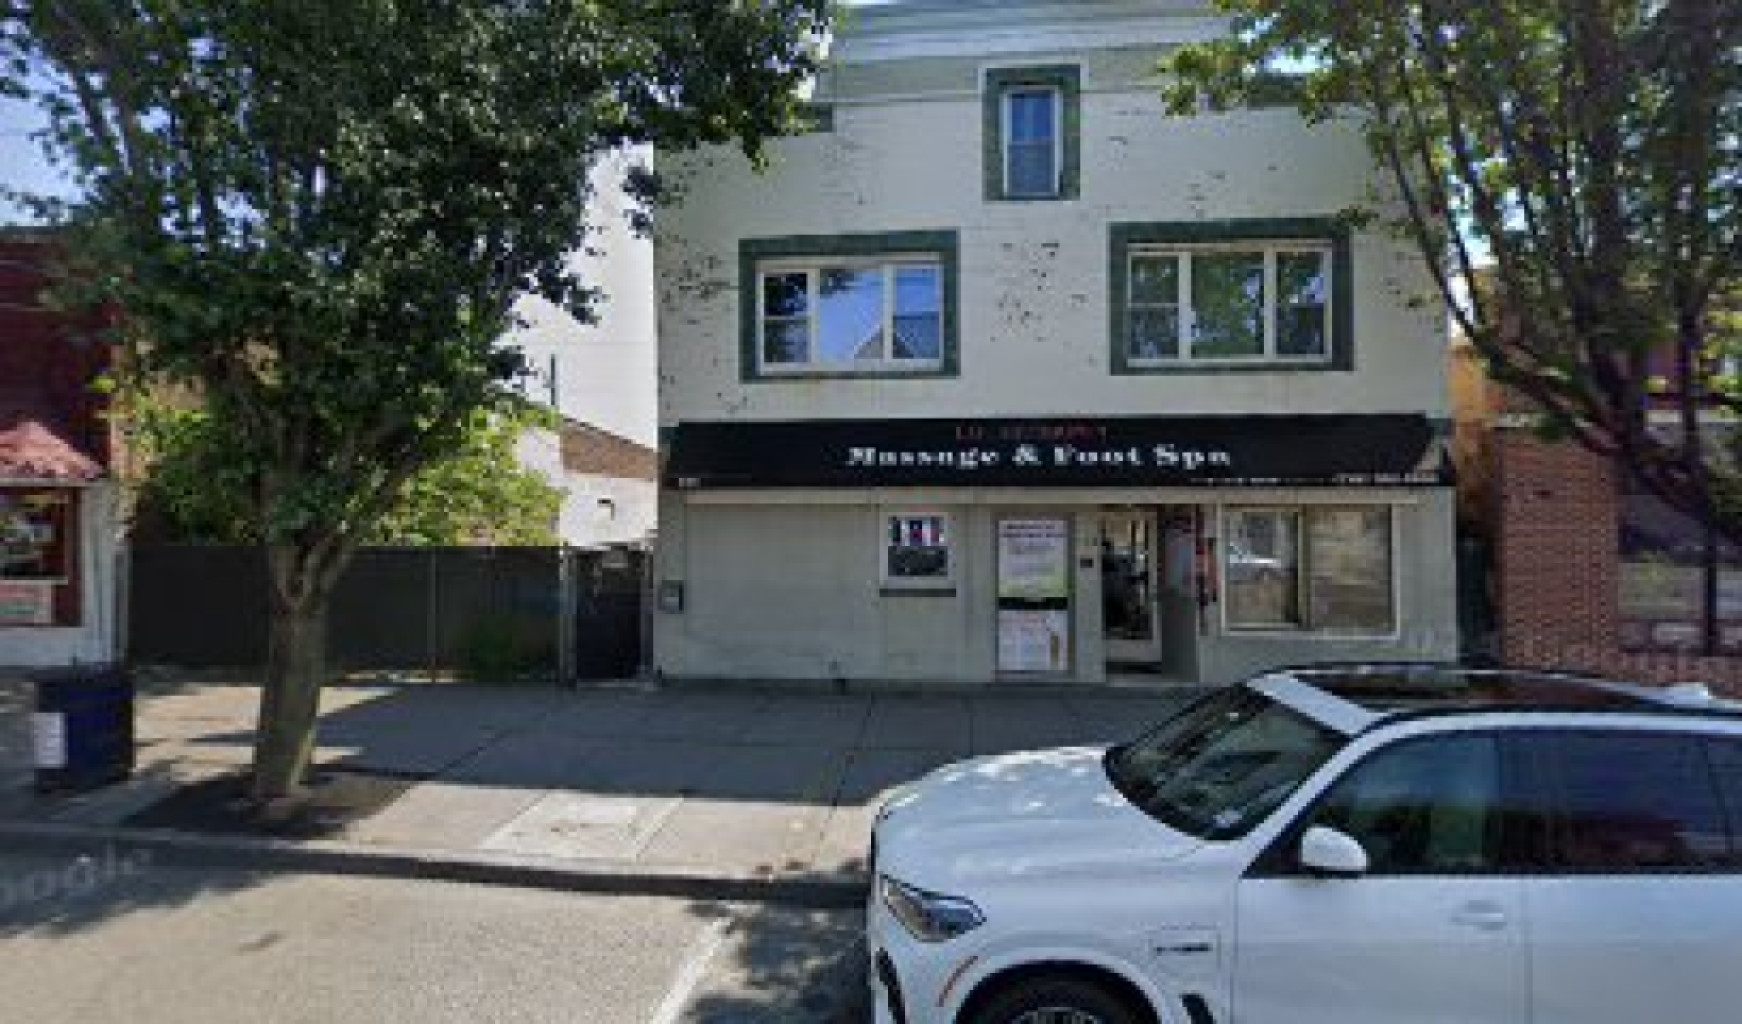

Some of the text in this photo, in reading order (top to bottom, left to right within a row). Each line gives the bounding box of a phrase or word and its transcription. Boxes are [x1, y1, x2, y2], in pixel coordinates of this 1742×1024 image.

[847, 443, 1232, 471] Massage & Foot Spa
